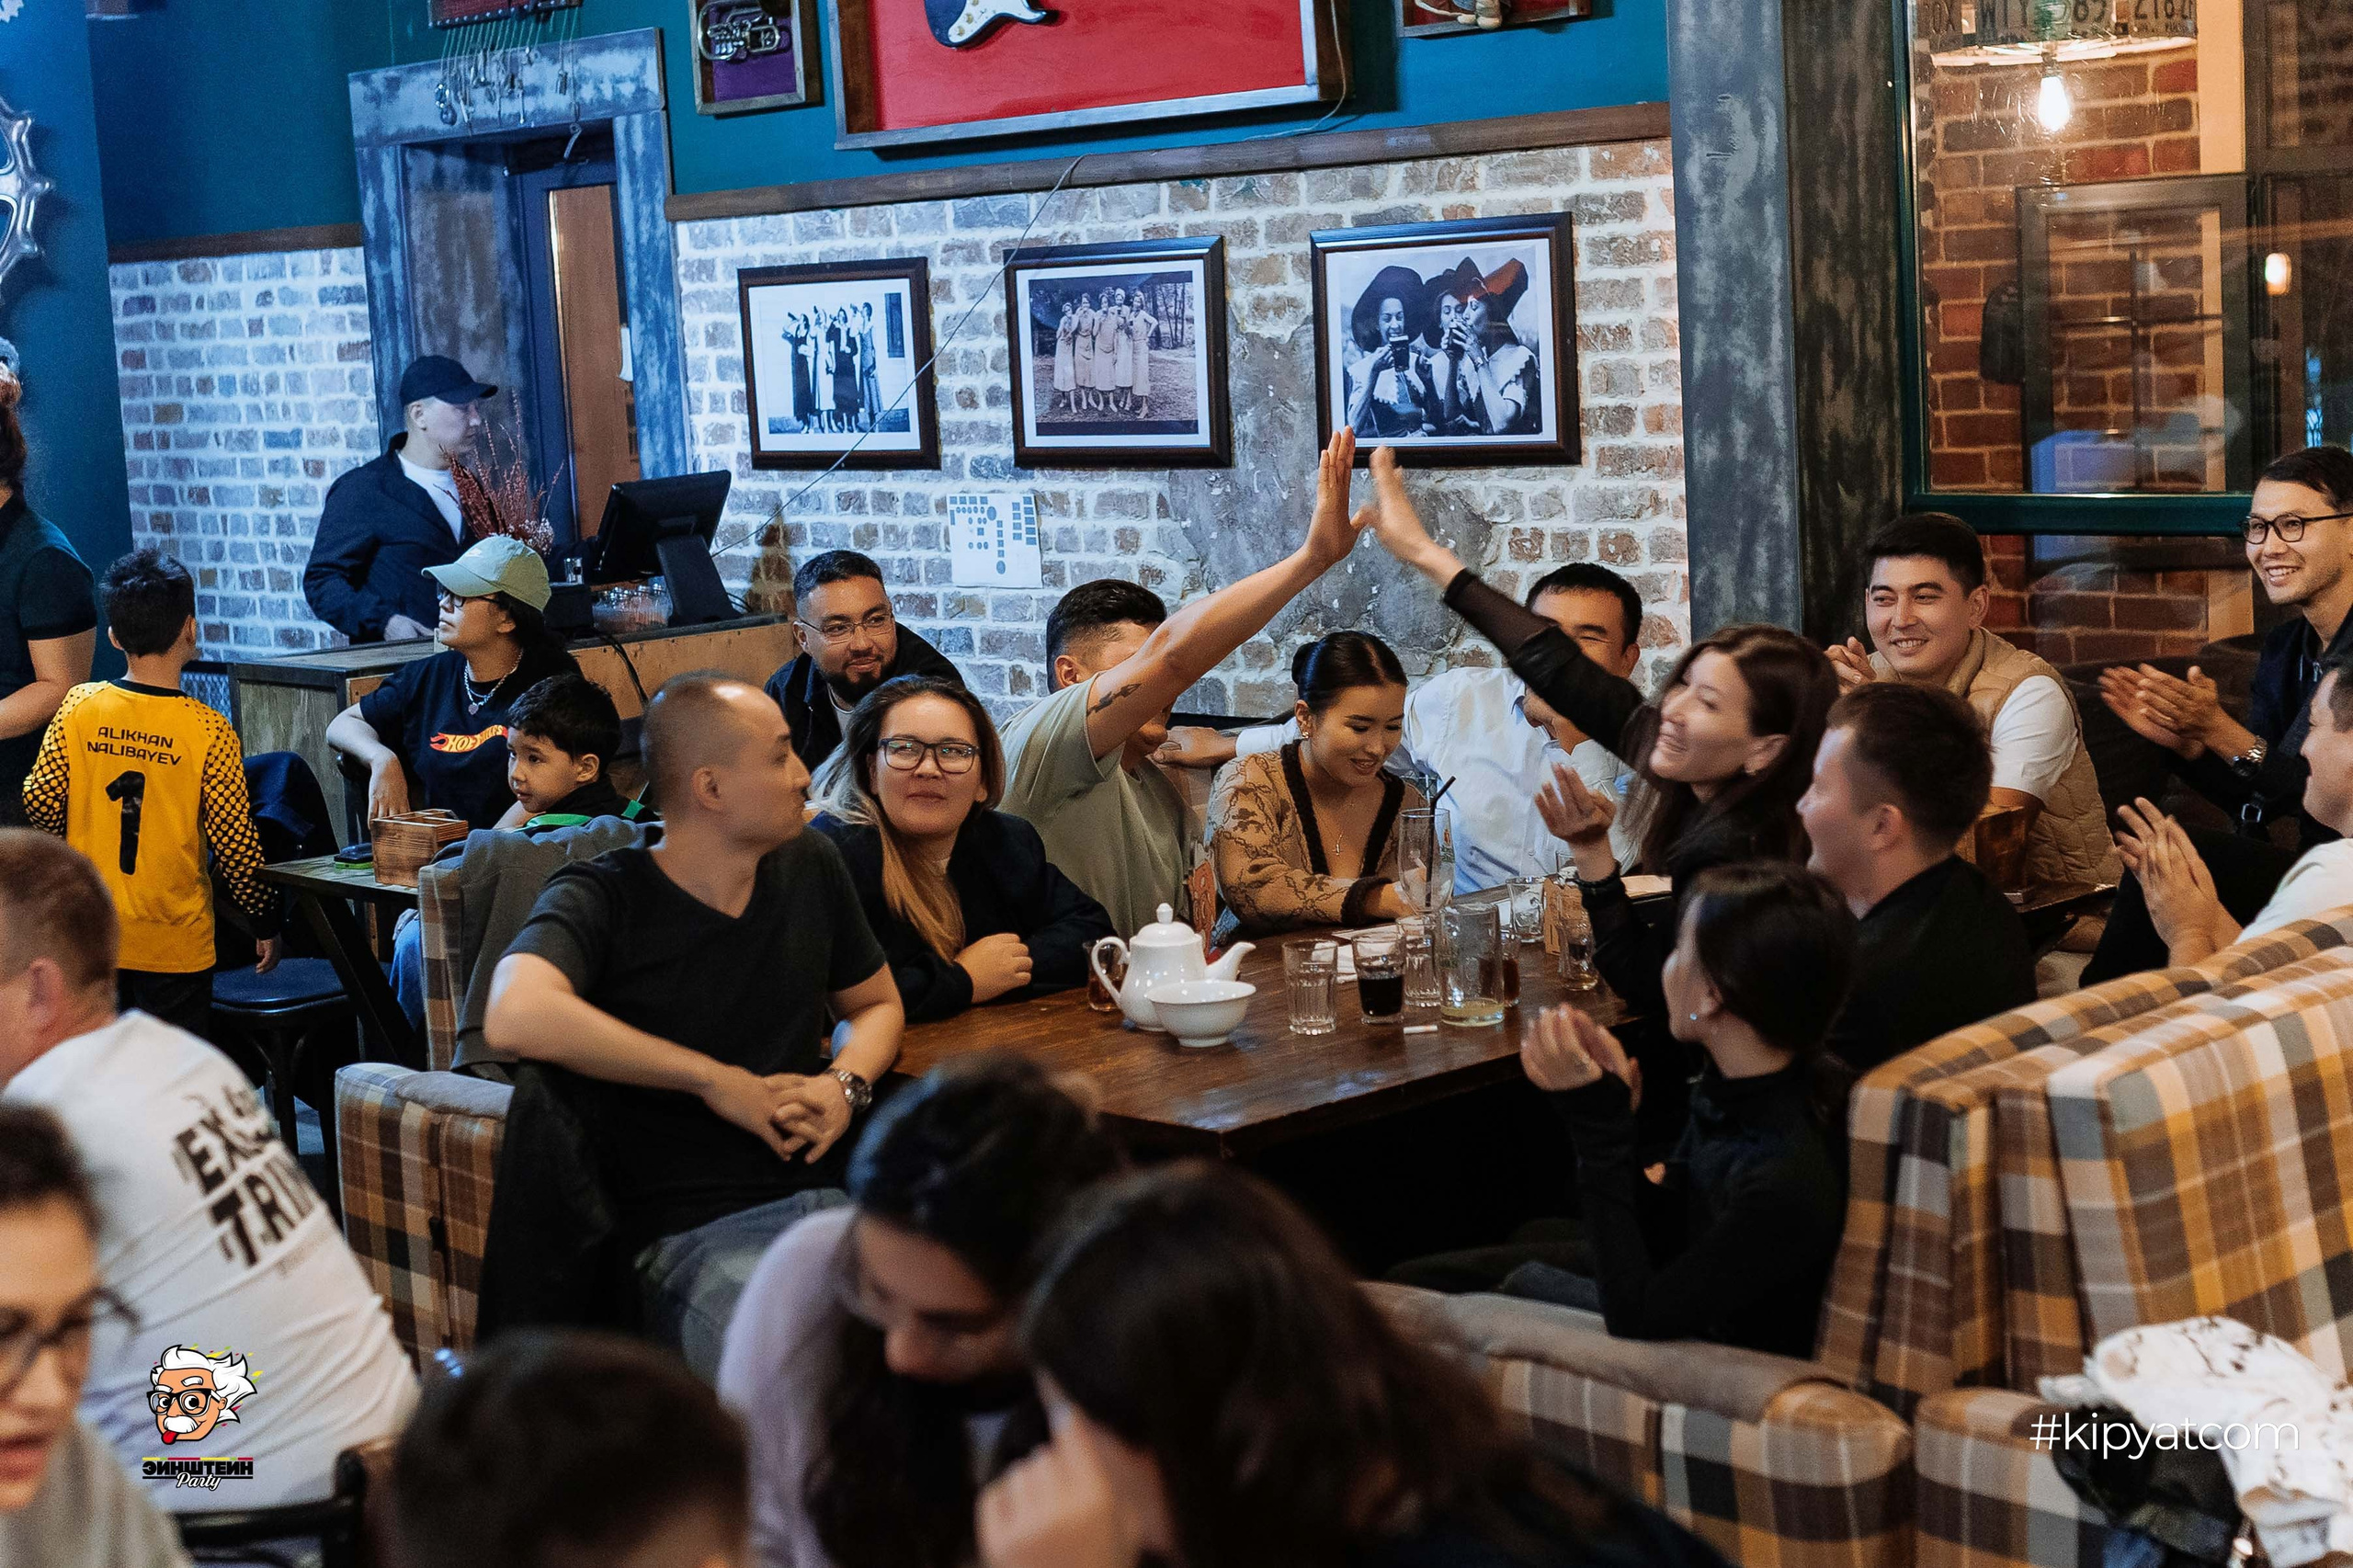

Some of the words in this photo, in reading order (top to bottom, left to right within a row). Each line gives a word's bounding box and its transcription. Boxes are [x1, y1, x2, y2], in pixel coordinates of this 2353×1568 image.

[97, 726, 174, 749] ALIKHAN
[86, 741, 182, 766] NALIBAYEV
[105, 770, 146, 876] 1
